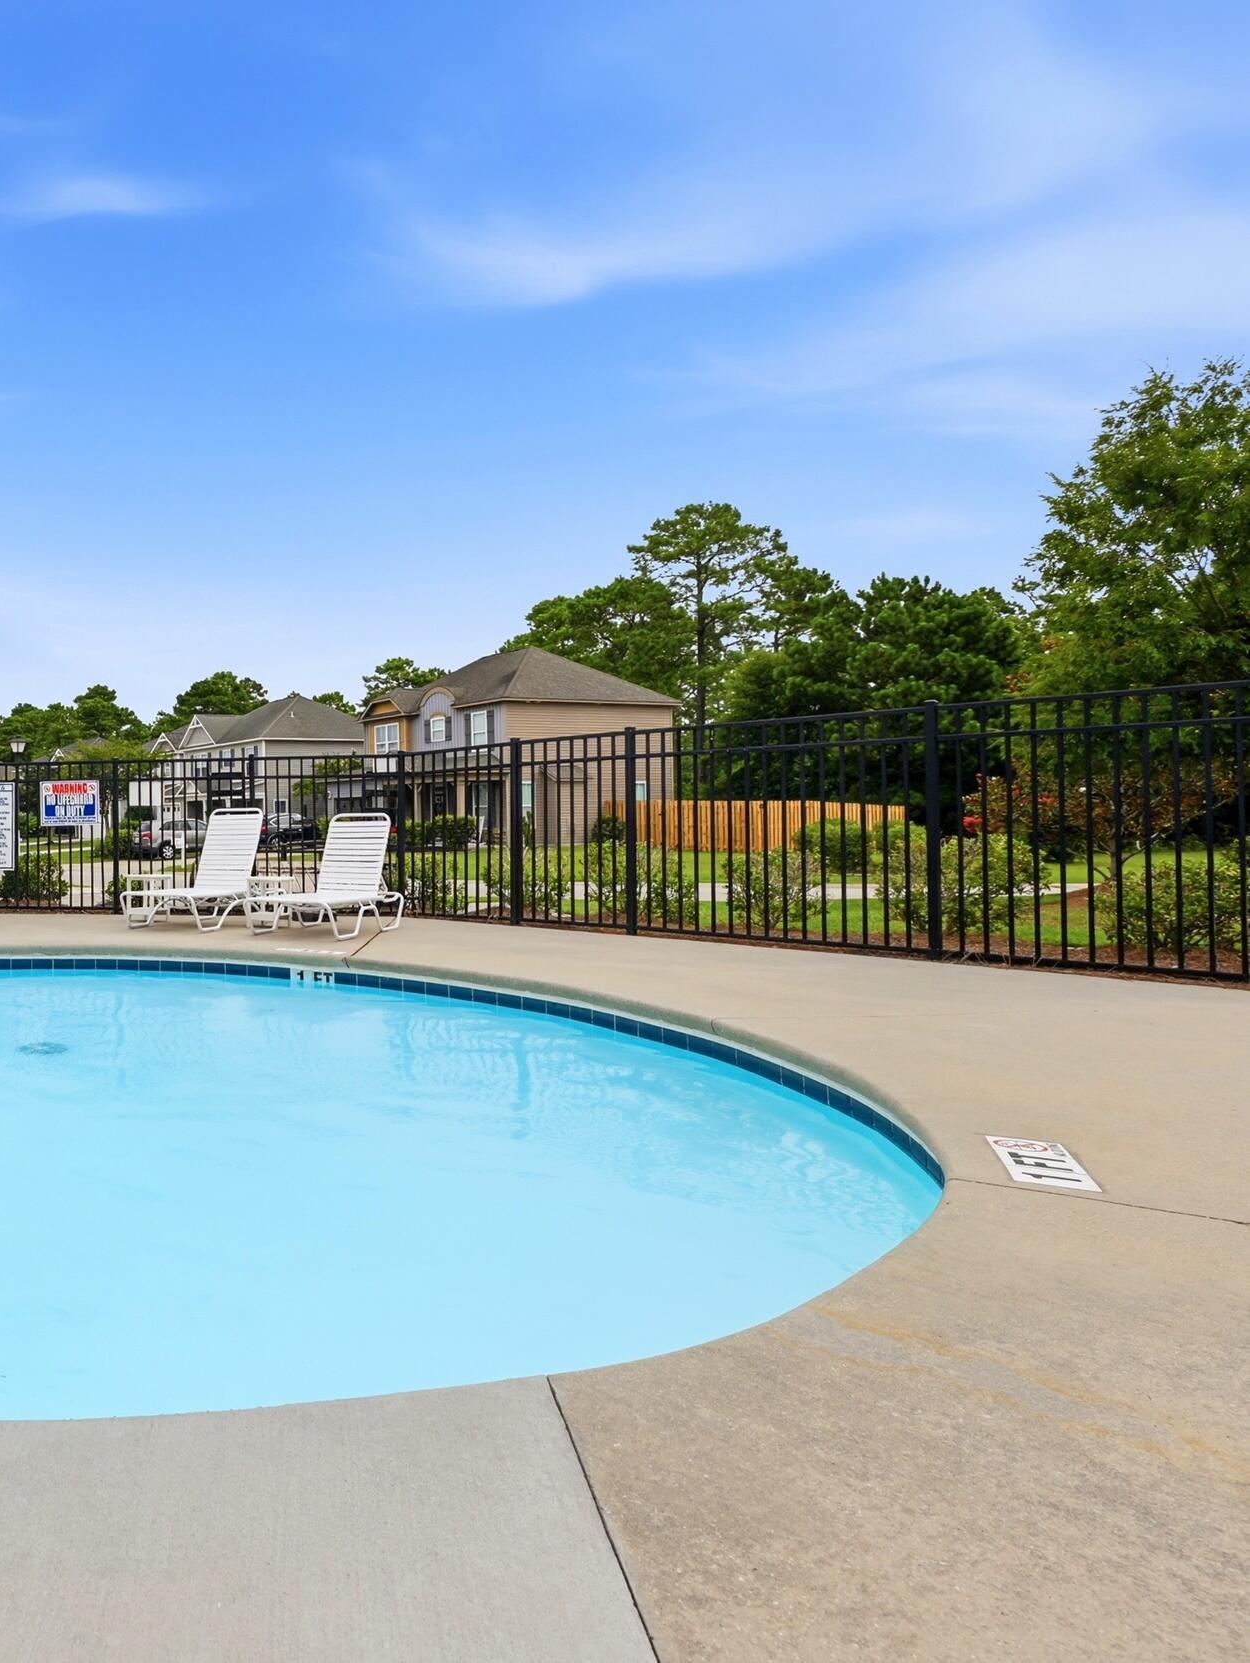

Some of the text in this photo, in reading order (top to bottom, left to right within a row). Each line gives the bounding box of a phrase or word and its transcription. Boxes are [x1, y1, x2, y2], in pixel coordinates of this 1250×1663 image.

[52, 783, 88, 794] WARNING
[46, 794, 94, 805] NO LIFEGUARD
[55, 805, 86, 817] ON DUTY
[297, 970, 304, 980] 1
[1007, 1151, 1082, 1182] 1 FT
